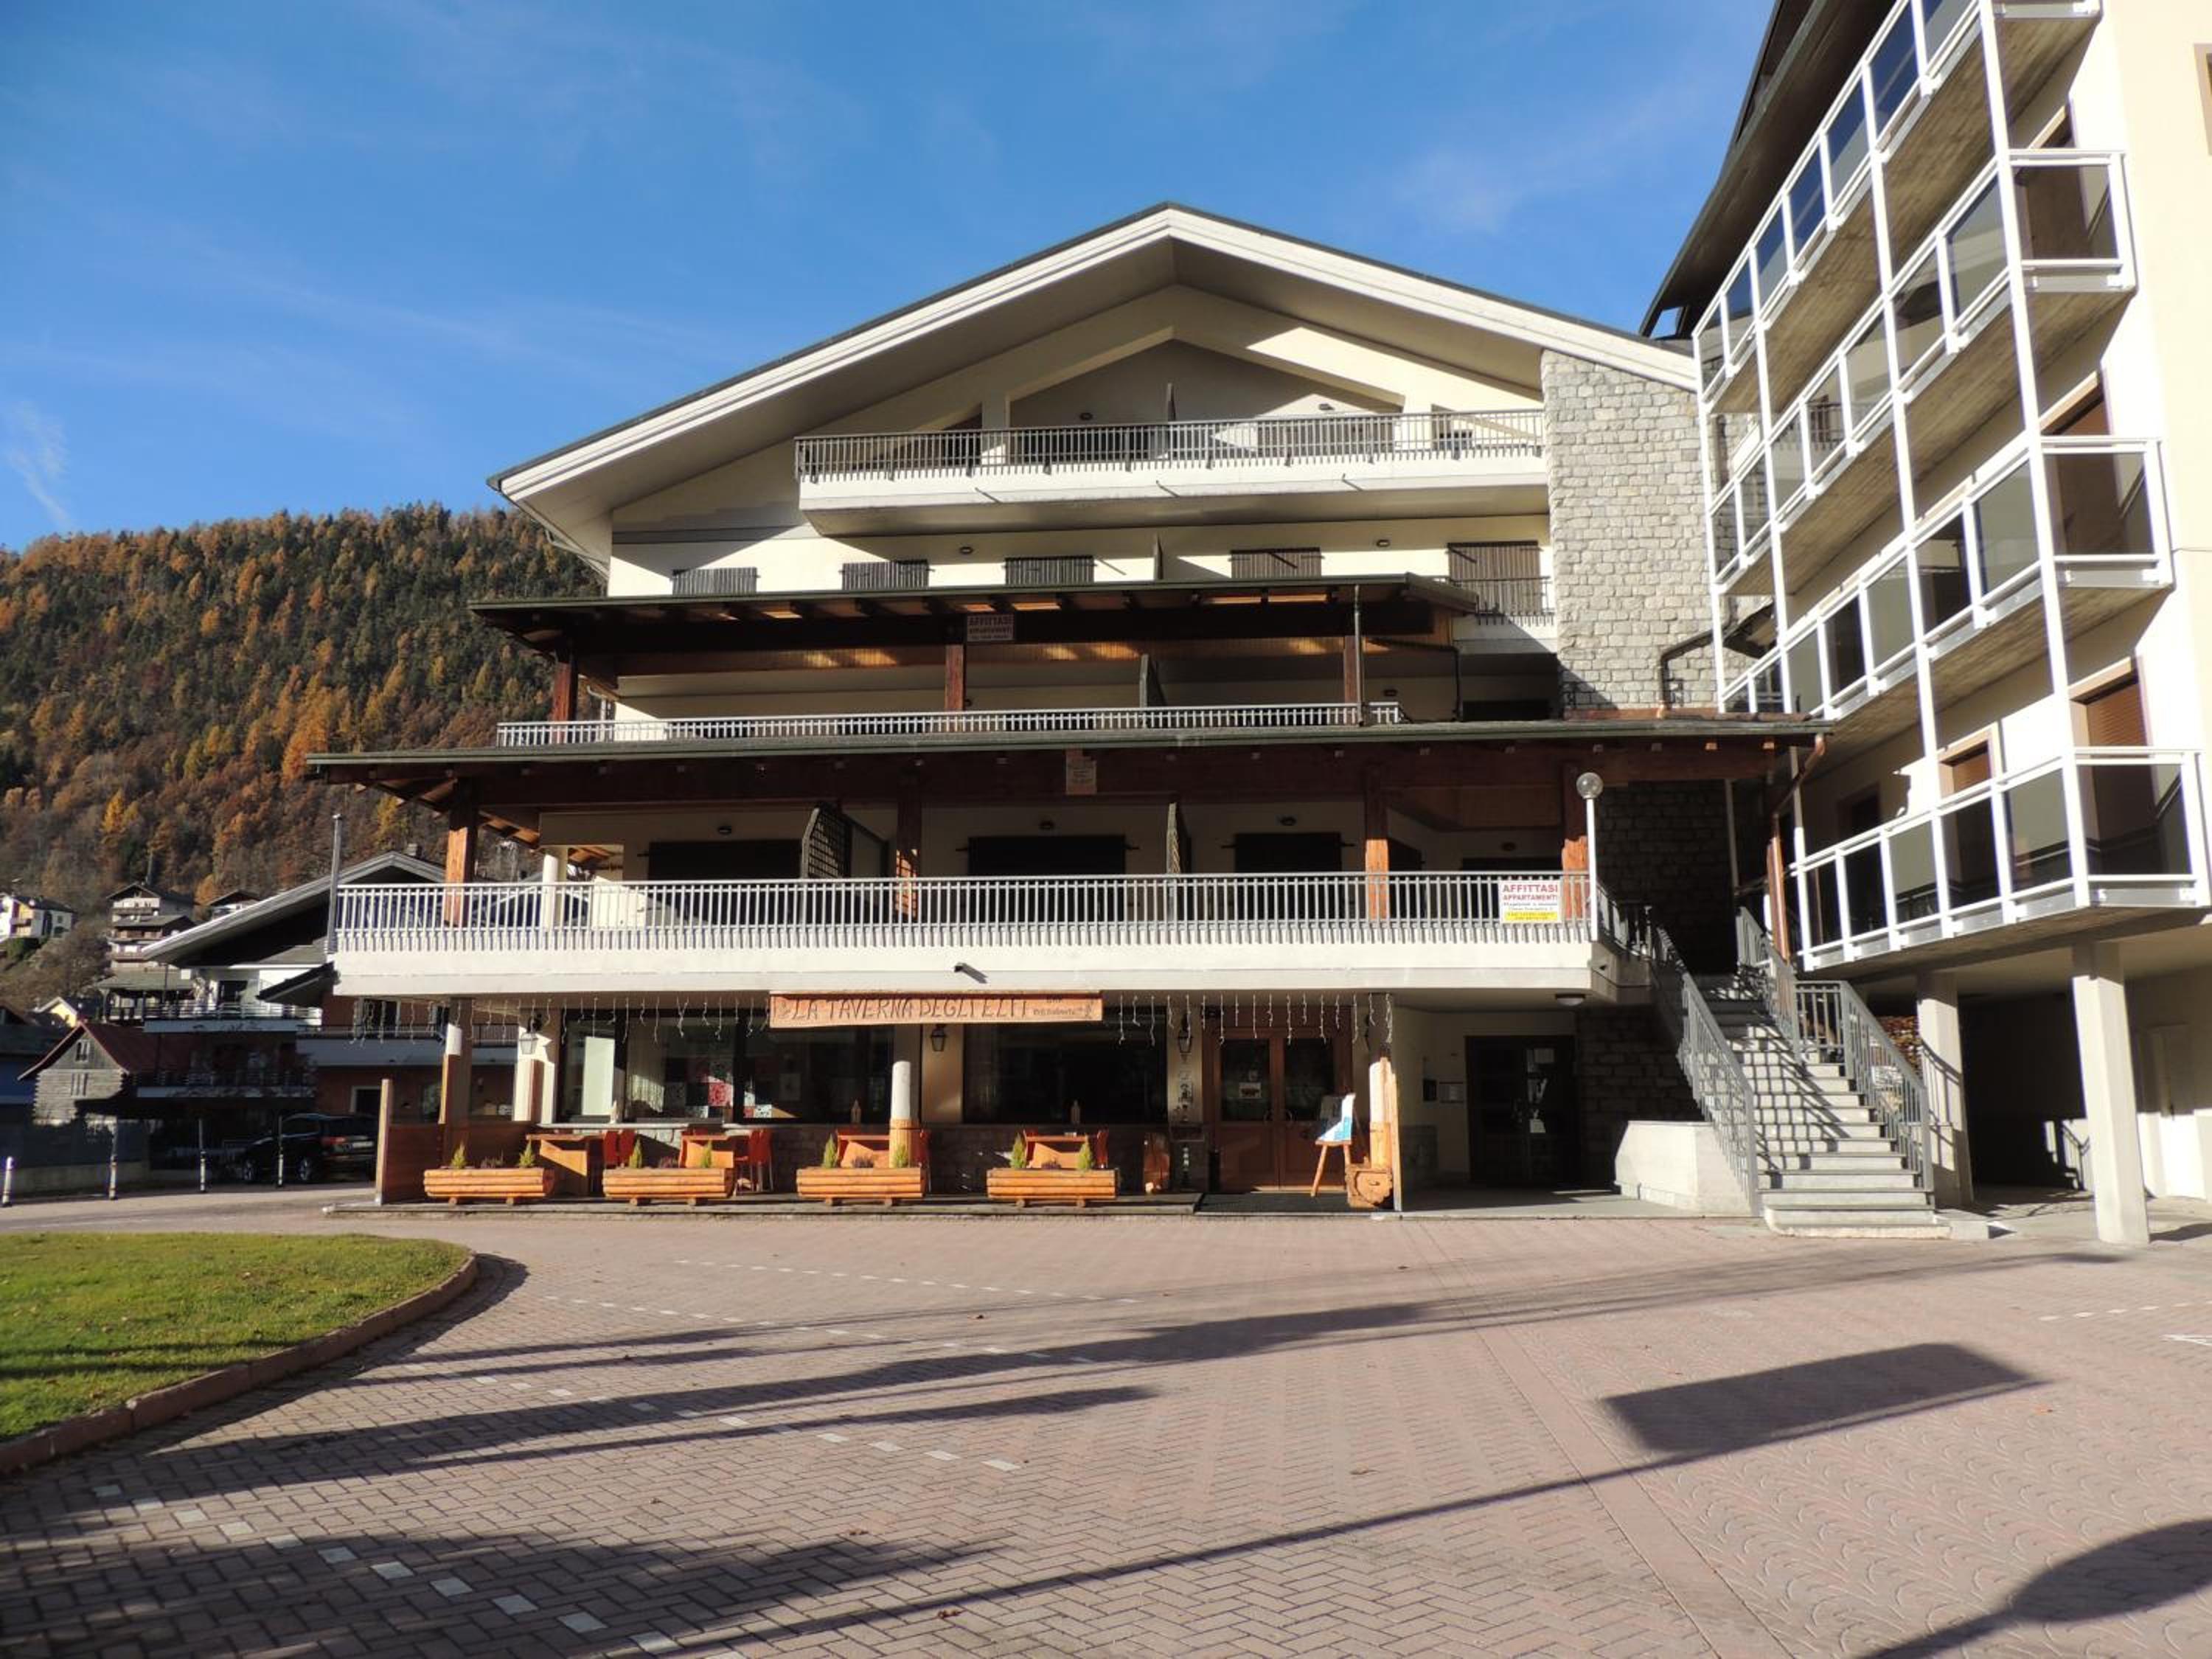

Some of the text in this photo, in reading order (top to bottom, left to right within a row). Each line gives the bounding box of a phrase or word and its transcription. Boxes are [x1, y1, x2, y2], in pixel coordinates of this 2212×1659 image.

[1503, 884, 1558, 893] AFFITTASI
[792, 998, 818, 1020] LA
[826, 998, 913, 1019] TAVERNA
[919, 997, 975, 1018] DEGLI
